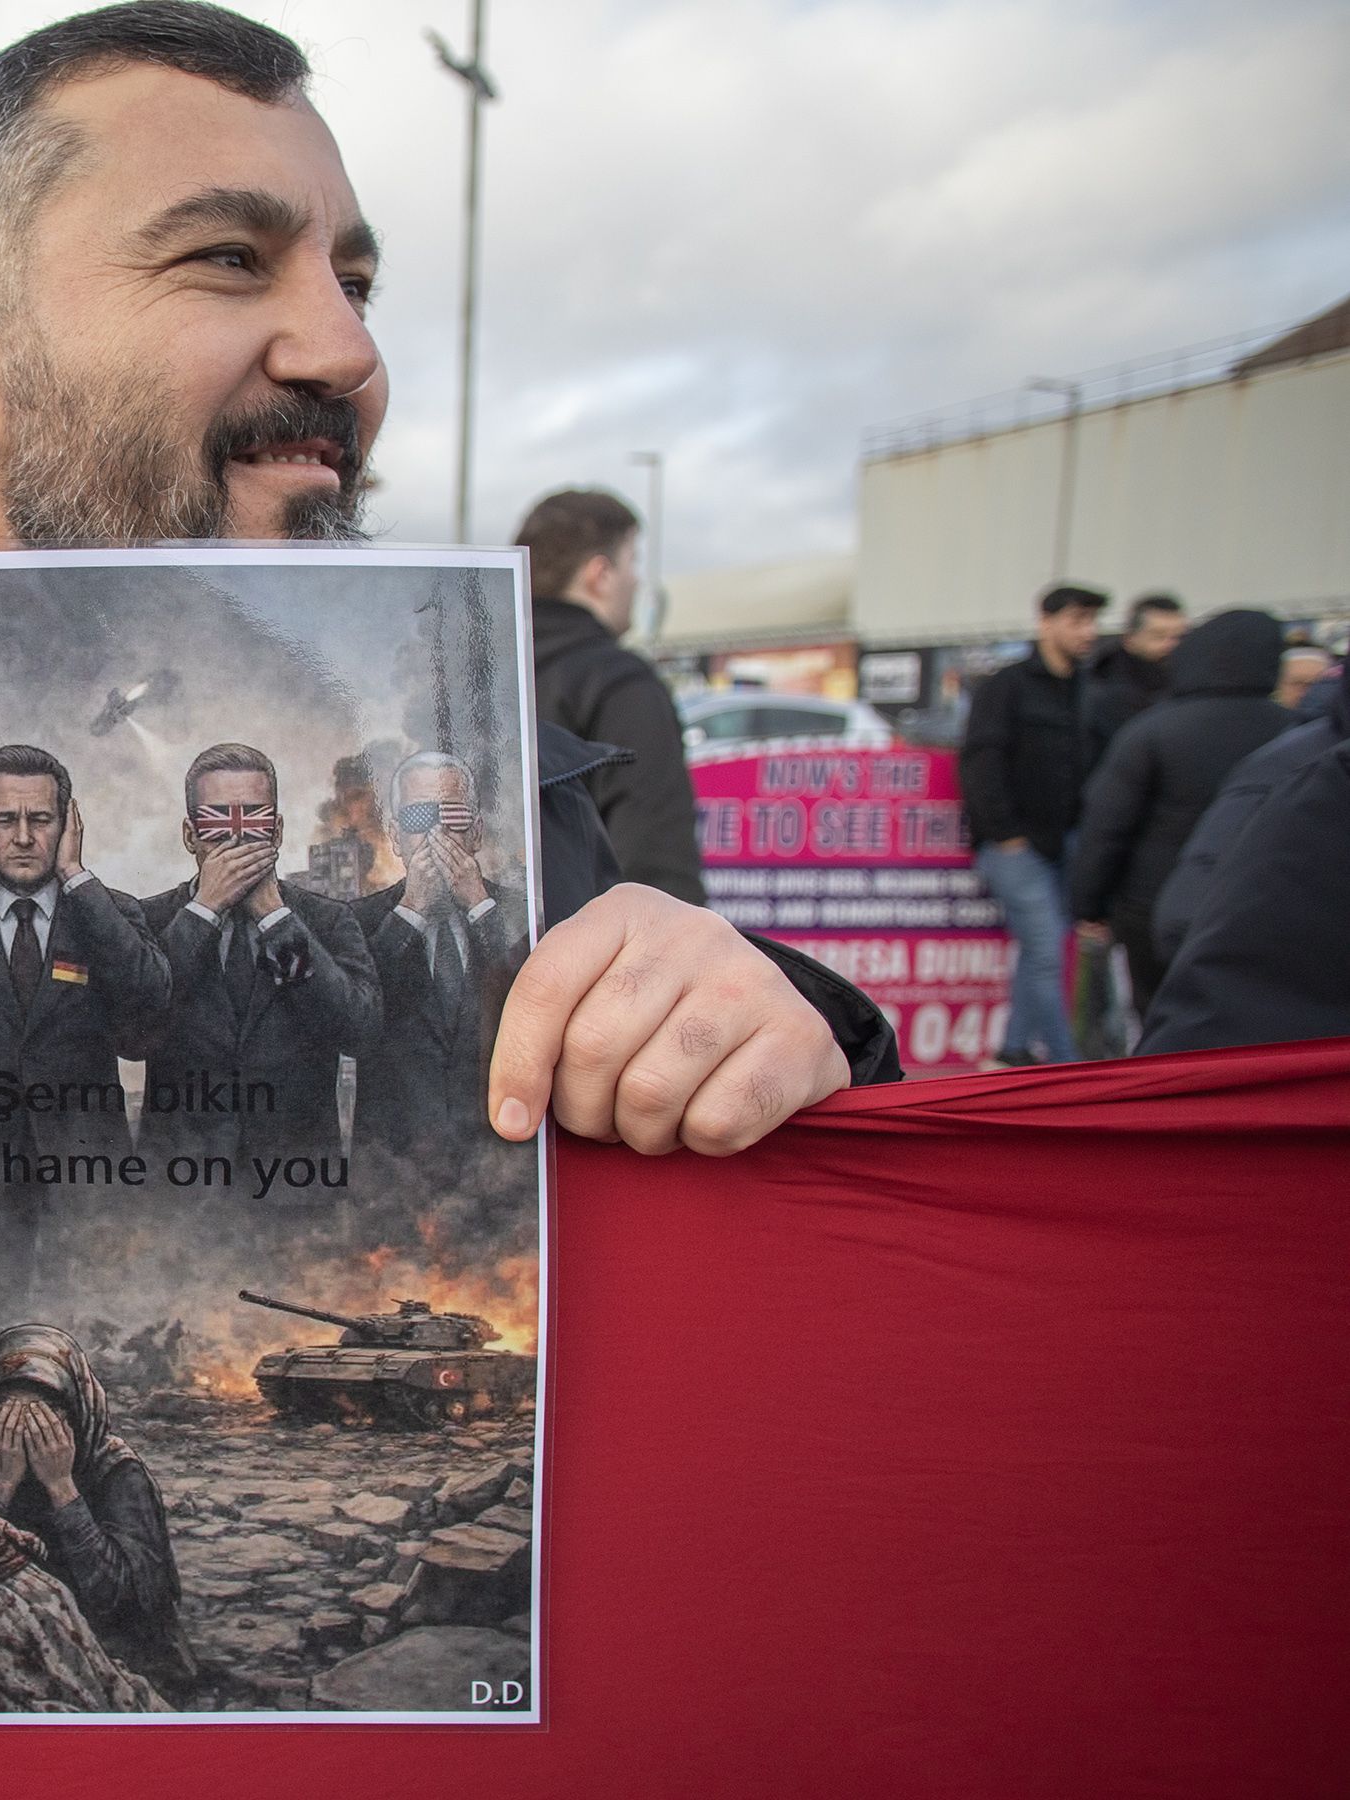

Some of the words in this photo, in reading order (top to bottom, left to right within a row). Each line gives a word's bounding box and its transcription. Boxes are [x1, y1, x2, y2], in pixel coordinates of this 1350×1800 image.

[753, 803, 802, 850] TO
[814, 803, 888, 850] SEE
[148, 1071, 276, 1112] bikin
[166, 1155, 233, 1187] on
[251, 1156, 349, 1200] you
[471, 1680, 524, 1705] D.D
